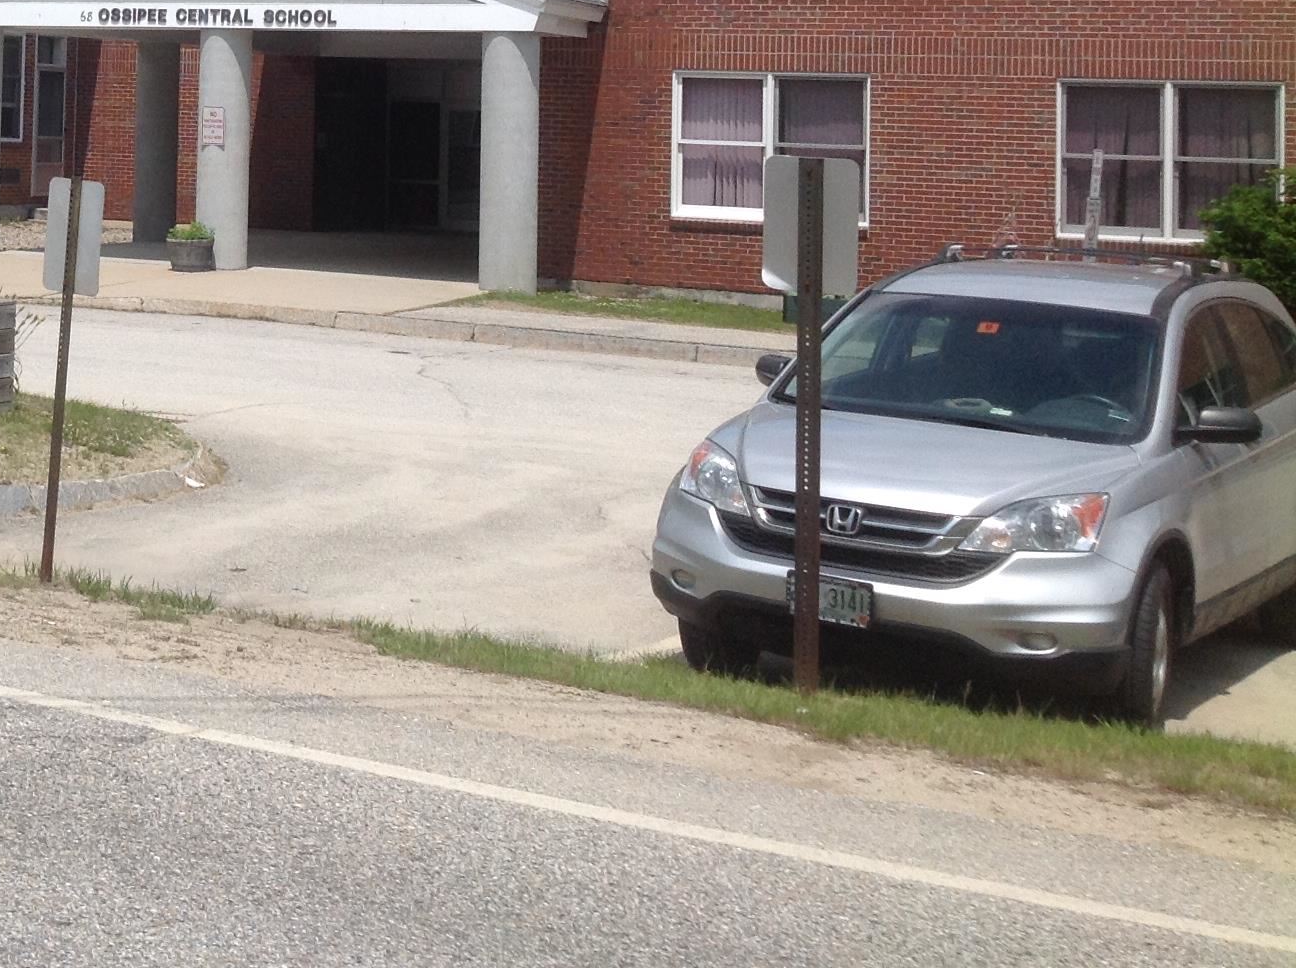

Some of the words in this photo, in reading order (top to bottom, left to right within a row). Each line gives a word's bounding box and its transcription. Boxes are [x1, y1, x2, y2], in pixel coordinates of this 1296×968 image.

[98, 7, 168, 25] OSSIPEE
[175, 8, 254, 26] CENTRAL
[263, 9, 337, 27] SCHOOL
